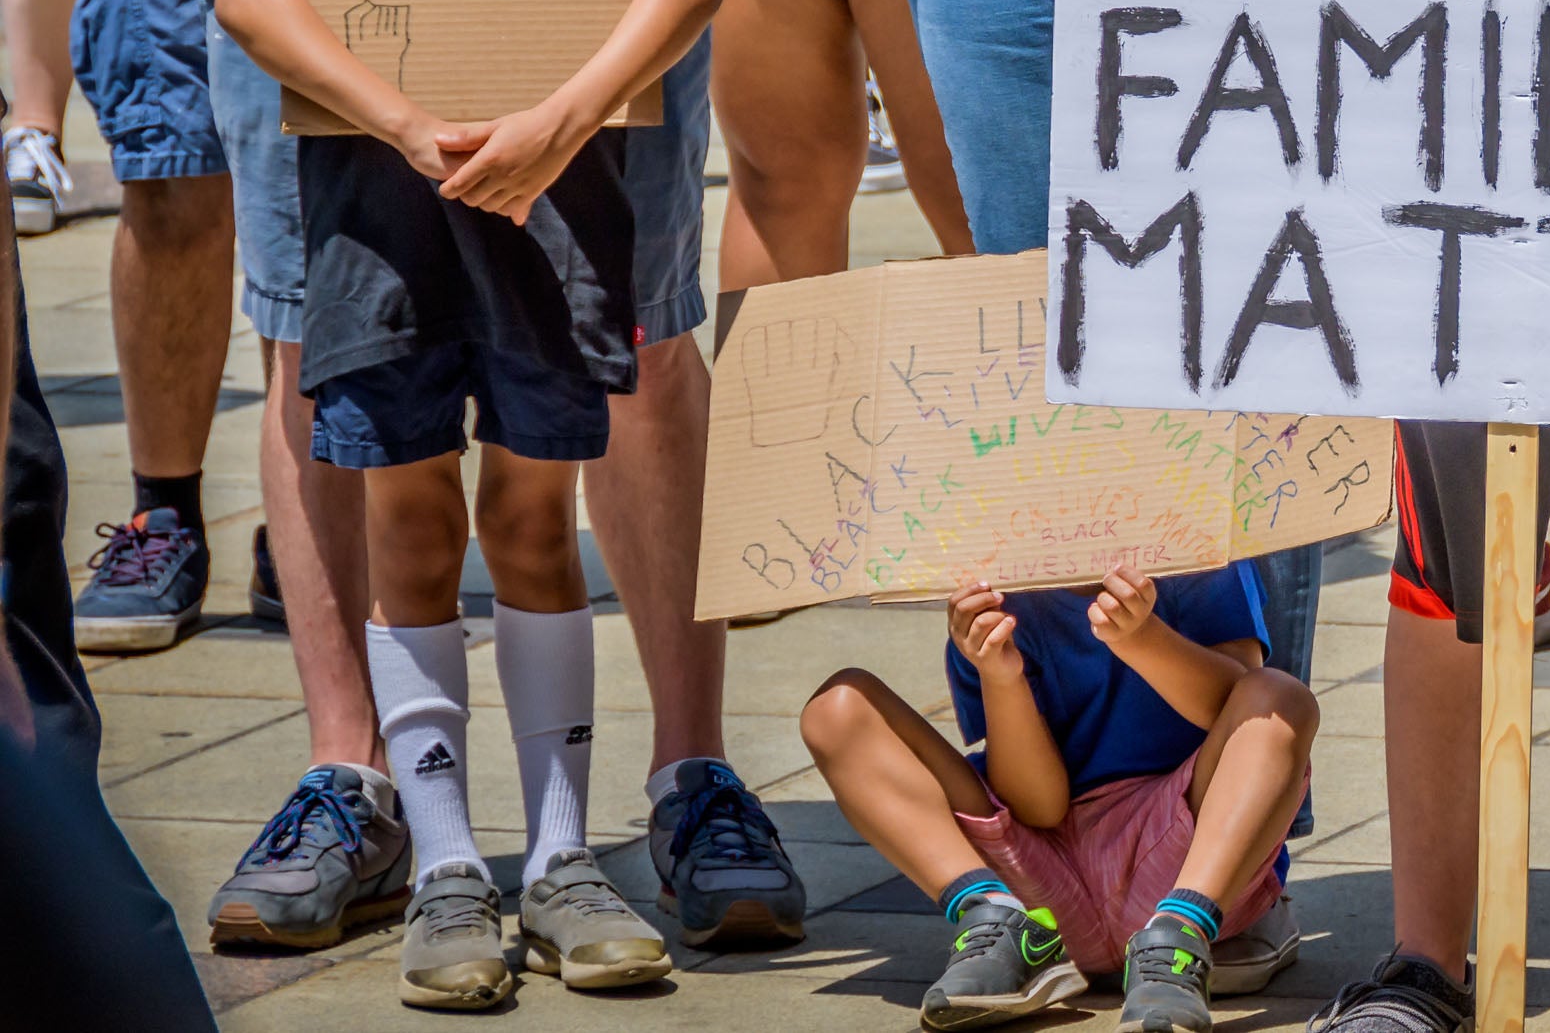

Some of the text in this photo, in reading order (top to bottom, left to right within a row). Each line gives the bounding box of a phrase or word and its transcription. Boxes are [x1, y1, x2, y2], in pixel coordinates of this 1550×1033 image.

[1012, 439, 1137, 484] LIVES
[865, 463, 965, 588] BLACK
[1038, 518, 1119, 548] BLACK
[997, 556, 1079, 582] LIVES
